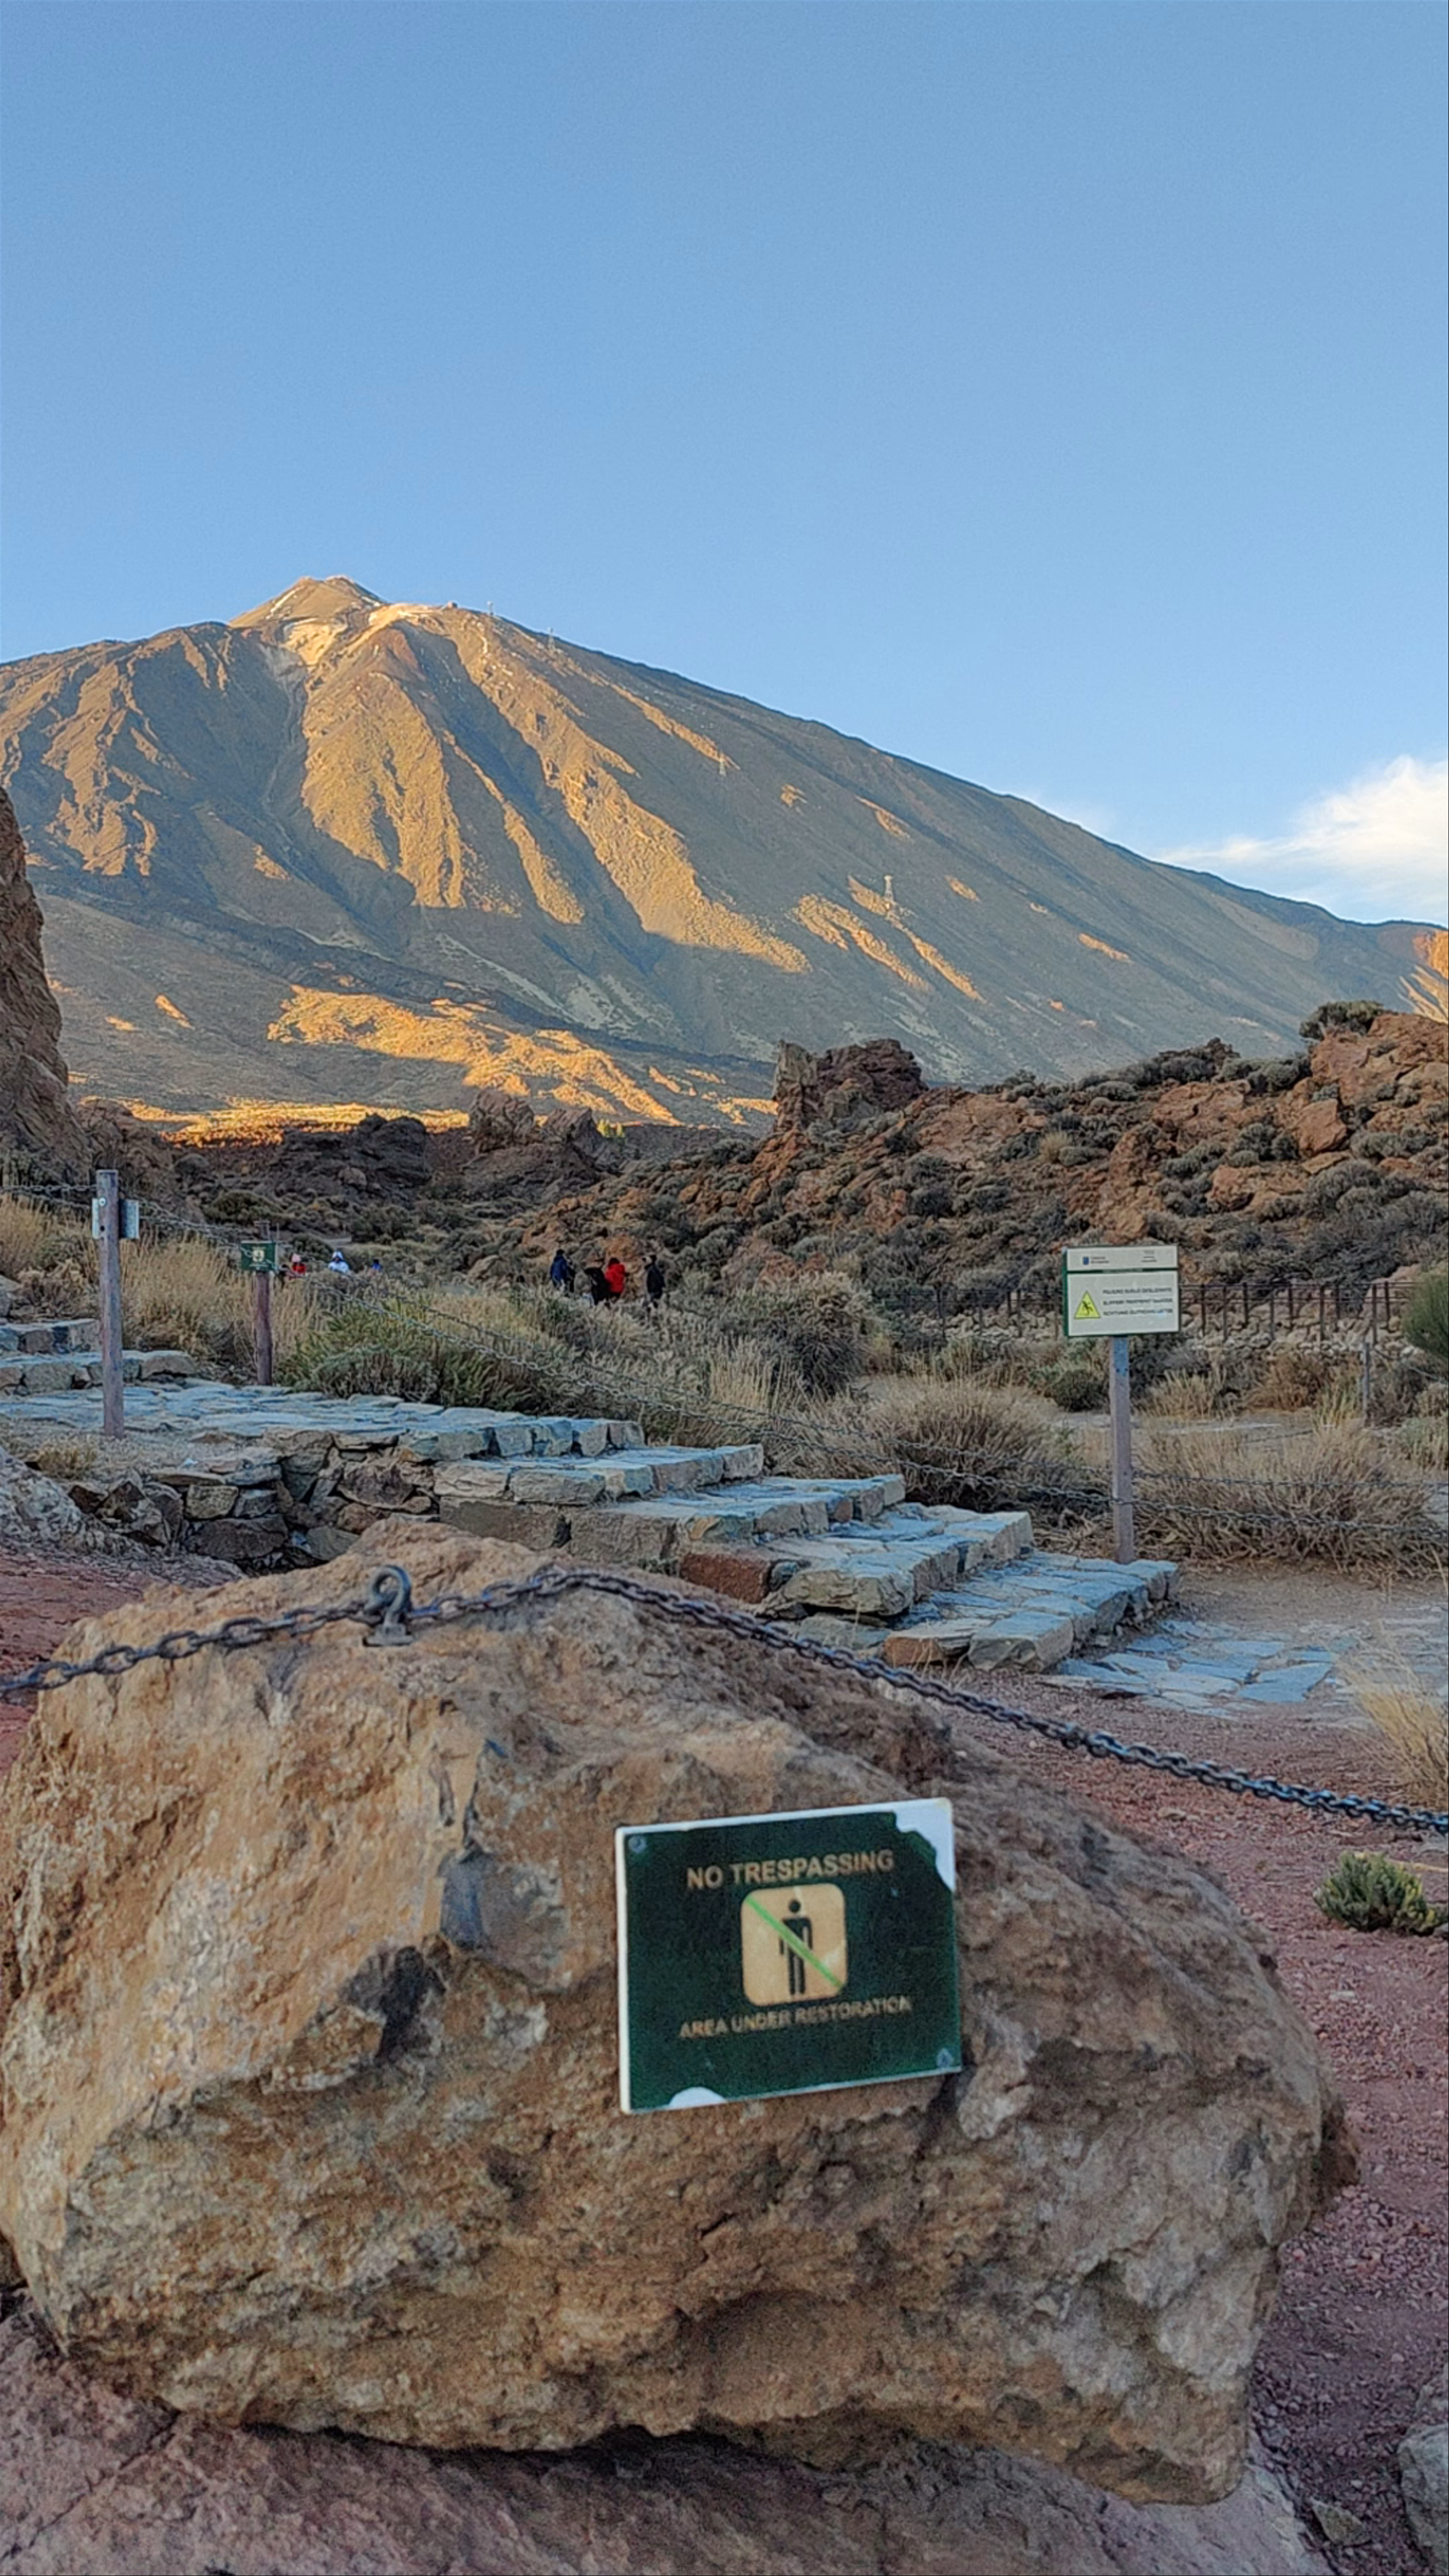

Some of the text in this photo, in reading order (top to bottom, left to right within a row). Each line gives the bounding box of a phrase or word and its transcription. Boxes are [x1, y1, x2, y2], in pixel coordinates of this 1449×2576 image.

[686, 1849, 894, 1890] NO TRESPASSING
[680, 1995, 912, 2038] AREA UNDER RESTORATION
